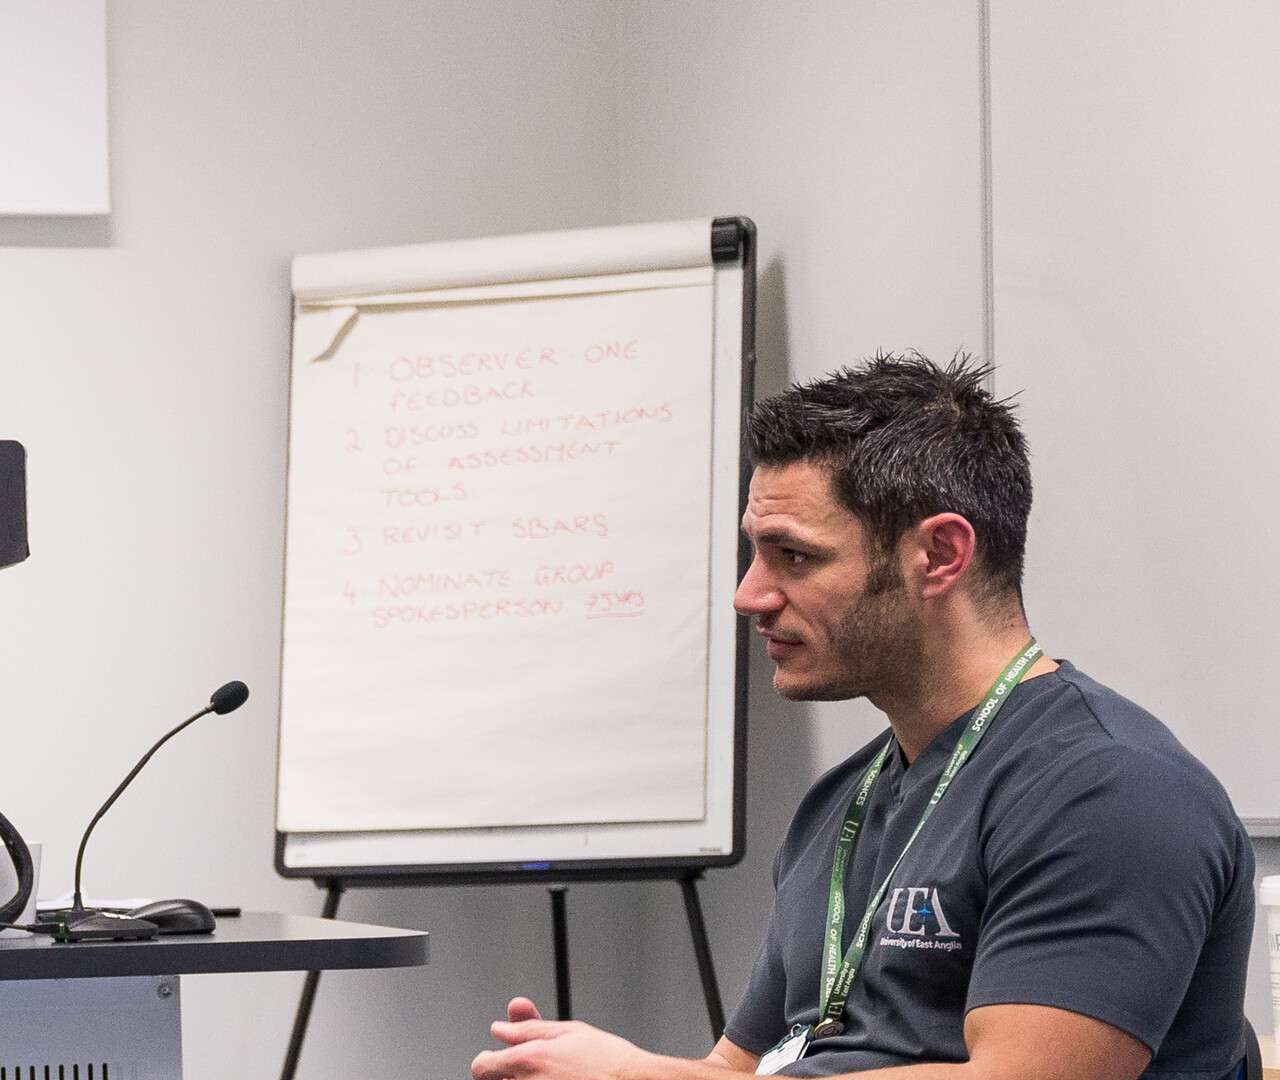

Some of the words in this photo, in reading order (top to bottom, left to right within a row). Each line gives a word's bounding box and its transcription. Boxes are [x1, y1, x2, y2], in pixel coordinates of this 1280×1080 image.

[389, 346, 558, 383] OBSERVER
[584, 339, 641, 365] ONE
[388, 381, 537, 414] FEEDBACK
[344, 428, 364, 453] 2
[384, 423, 480, 450] DISCUSS
[500, 402, 675, 438] LIMITATIONS
[382, 457, 418, 476] OF
[447, 438, 623, 471] ASSESSMENT
[381, 482, 468, 509] TOOLS
[342, 529, 363, 557] 3
[383, 520, 486, 546] REVISIT
[511, 512, 610, 540] SBARS
[377, 568, 513, 599] NOMINATE
[534, 560, 617, 587] GROUP
[370, 598, 564, 630] SPOKESPERSON
[972, 697, 999, 732] SCHOOL
[995, 682, 1008, 695] OF
[1005, 656, 1029, 682] HEALTH
[831, 892, 842, 929] SCHOOL
[886, 887, 961, 937] UEA
[855, 911, 873, 949] SCHOOL
[916, 939, 933, 949] East
[934, 941, 963, 952] Anglia
[827, 943, 837, 975] HEALTH
